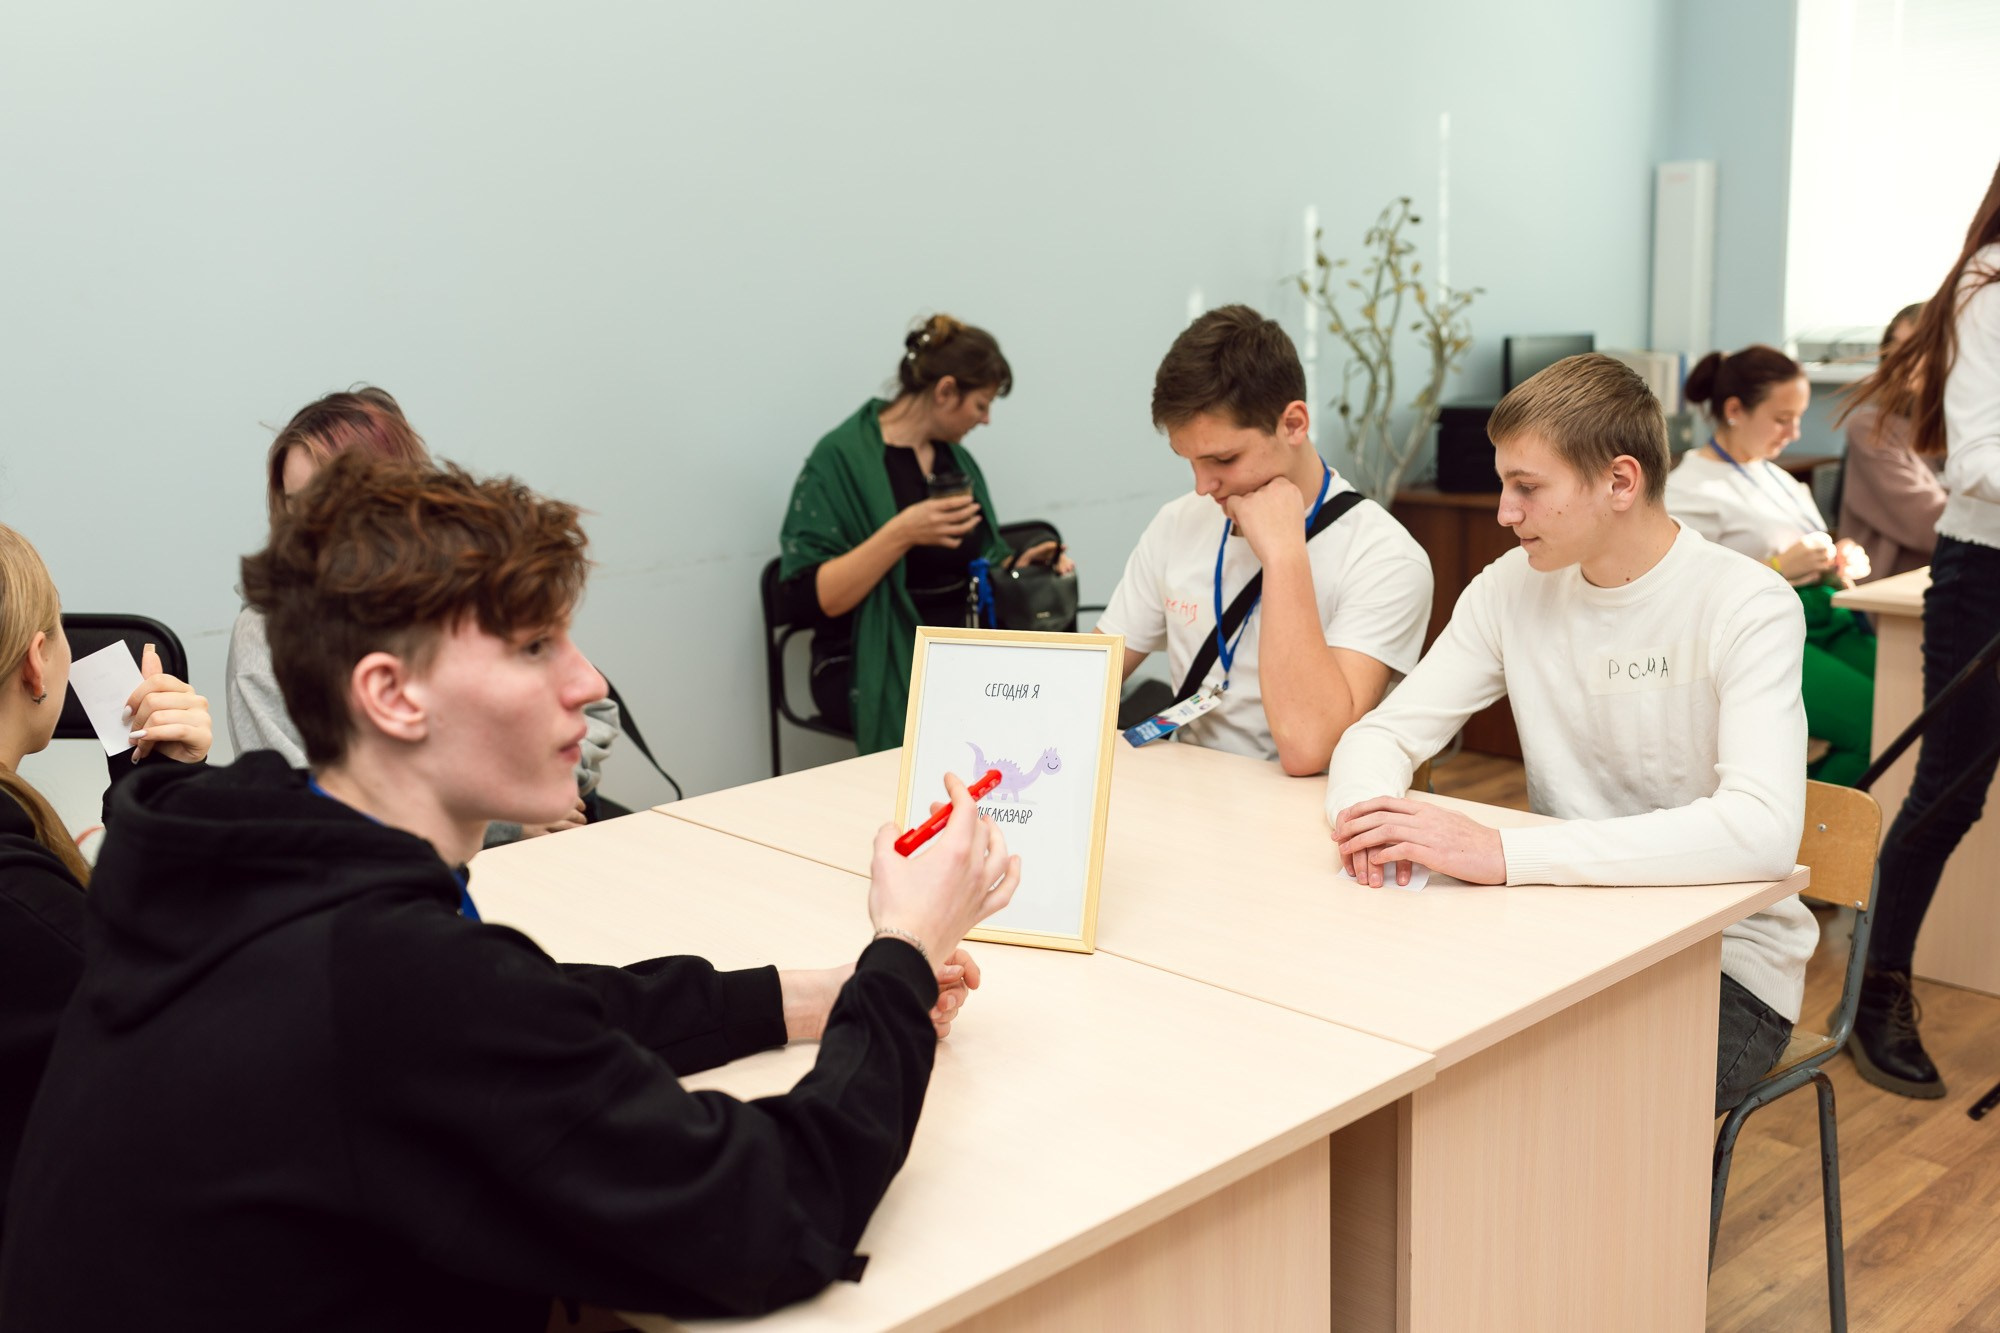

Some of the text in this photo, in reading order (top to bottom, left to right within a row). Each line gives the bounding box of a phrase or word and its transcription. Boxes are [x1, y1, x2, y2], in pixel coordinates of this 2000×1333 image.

[1608, 656, 1669, 680] РОМА
[984, 683, 1041, 702] СЕГОДНЯ Я
